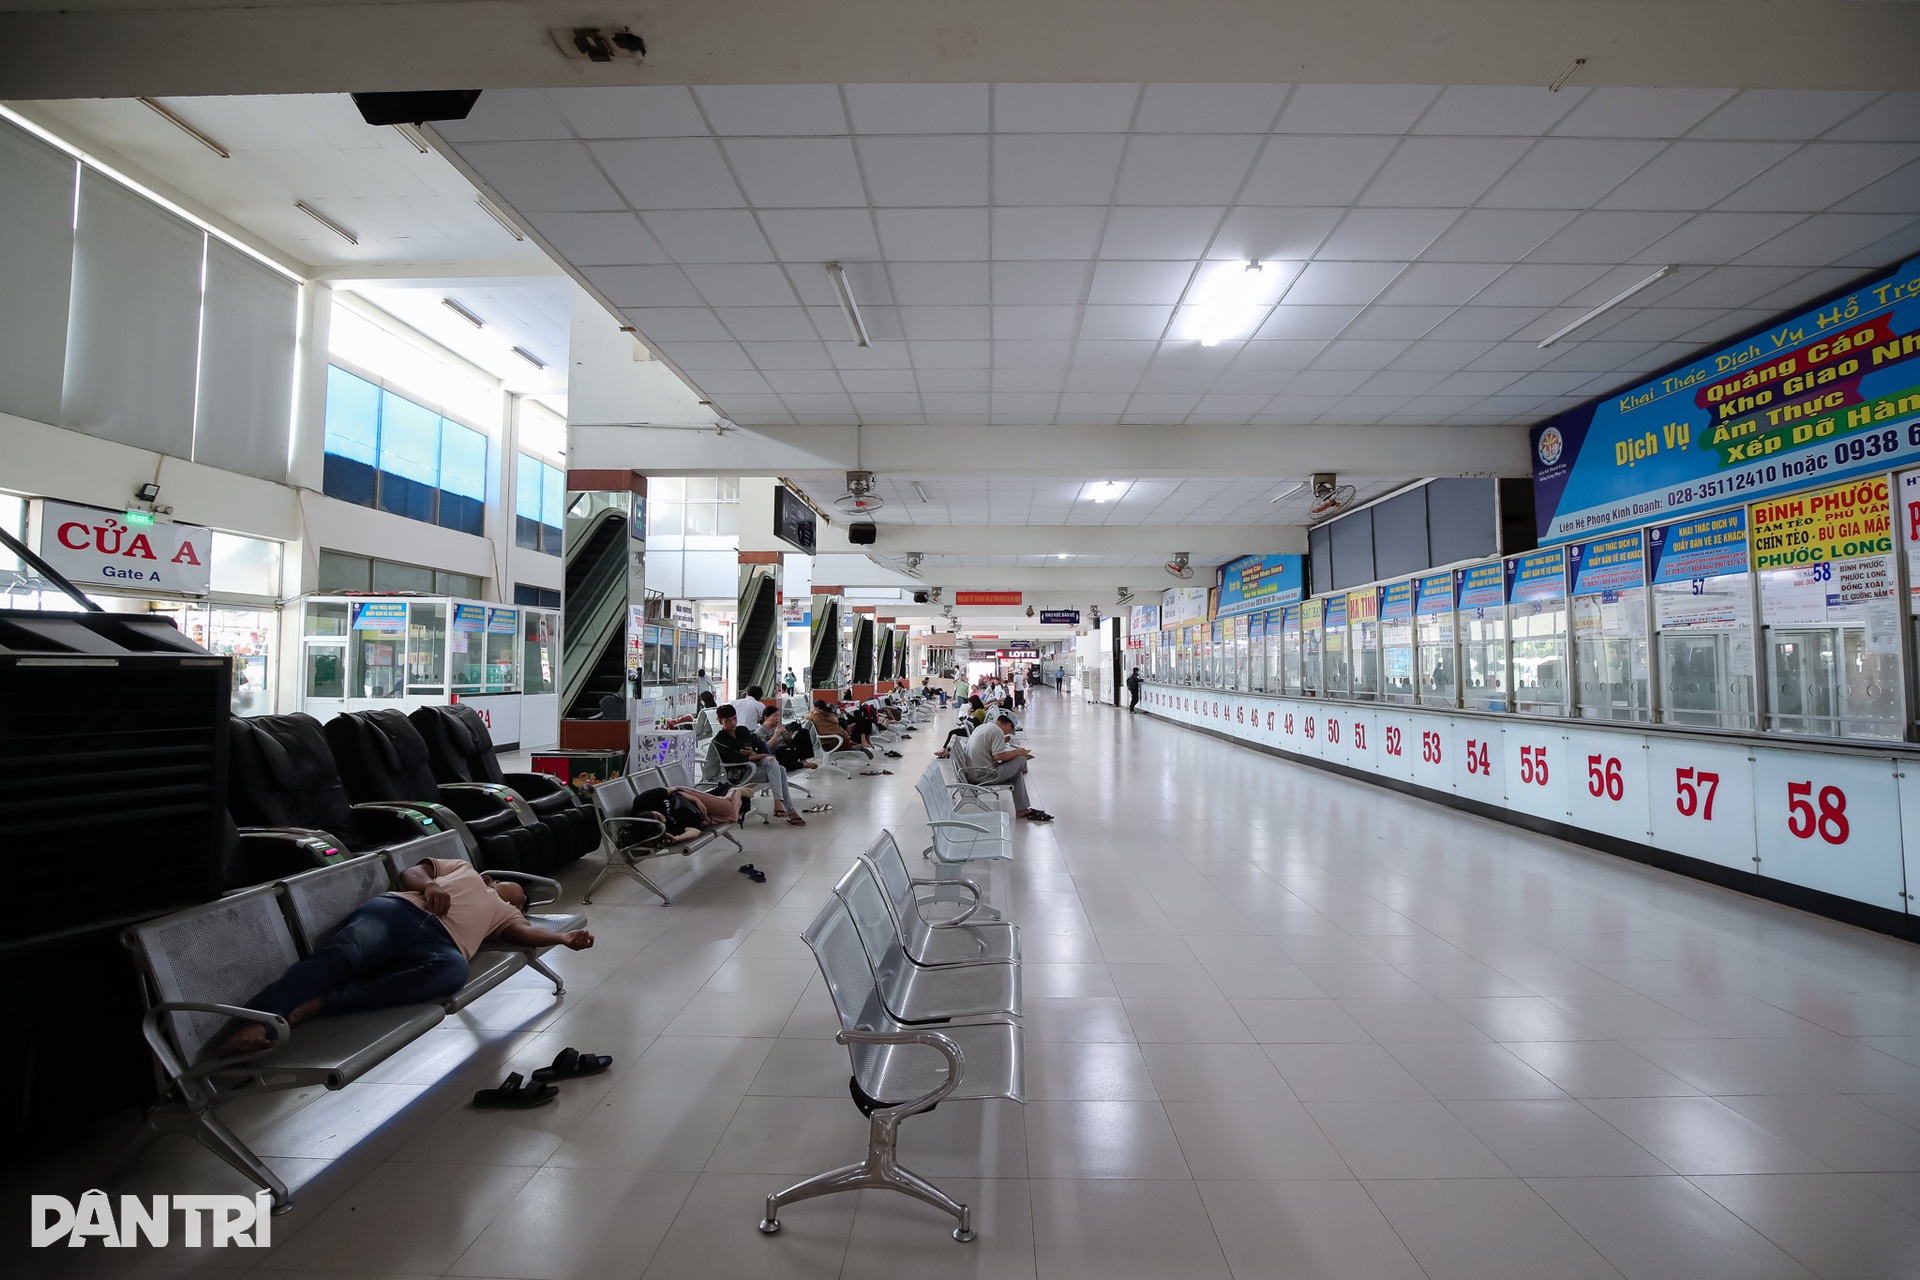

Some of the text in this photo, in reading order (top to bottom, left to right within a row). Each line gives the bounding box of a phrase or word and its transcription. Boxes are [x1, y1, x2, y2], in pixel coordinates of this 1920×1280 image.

[1620, 387, 1654, 411] Khai
[1662, 368, 1706, 393] Thác
[1715, 345, 1760, 371] Dịch
[1771, 328, 1803, 346] Vụ
[1816, 295, 1859, 329] Hỗ
[1707, 328, 1875, 402] Quảng Cáo
[1718, 390, 1772, 419] Kho
[1783, 359, 1859, 396] Giao
[1713, 391, 1844, 445] Ẩm Thực
[1615, 422, 1690, 467] Dịch Vụ
[1727, 434, 1782, 464] Xếp
[1792, 416, 1836, 445] Dỡ
[1559, 519, 1574, 533] Liên
[1576, 515, 1585, 530] Hệ
[1586, 512, 1610, 527] Phòng
[1612, 507, 1631, 521] Kinh
[1633, 499, 1663, 515] Doanh:
[1668, 466, 1776, 506] 028-35112410
[1782, 454, 1828, 477] hoặc
[1834, 429, 1899, 465] 0938
[1755, 482, 1889, 525] BÌNH PHƯỚC
[131, 514, 150, 524] EXIT
[1678, 516, 1738, 537] KHAI THÁC DỊCH VỤ
[1755, 522, 1783, 534] TÁM
[1786, 517, 1814, 528] TÈO
[1824, 508, 1854, 522] PHÚ
[57, 518, 202, 566] CỬA A
[1714, 532, 1722, 544] XE
[1724, 529, 1746, 543] KHÁCH
[1756, 531, 1783, 551] CHÍN
[1786, 528, 1809, 547] TÈO
[1818, 522, 1835, 541] BÙ
[1838, 521, 1861, 538] GIA
[1757, 537, 1892, 568] PHƯỚC LONG
[102, 566, 160, 582] Gate A
[1813, 562, 1831, 582] 58
[1867, 570, 1886, 578] LONG
[1692, 580, 1704, 595] 57
[1477, 608, 1484, 619] 54
[1213, 702, 1218, 718] 43
[1224, 704, 1230, 721] 44
[1237, 706, 1244, 724] 45
[1251, 708, 1258, 728] 46
[1267, 711, 1274, 731] 47
[1284, 713, 1294, 735] 48
[1304, 716, 1315, 739] 49
[1328, 718, 1340, 744] 50
[1354, 722, 1367, 750] 51
[1386, 726, 1402, 756] 52
[1423, 731, 1442, 764] 53
[1467, 740, 1490, 776] 54
[1520, 746, 1549, 786] 55
[1588, 754, 1624, 801] 56
[1676, 766, 1719, 820] 57
[1788, 781, 1850, 845] 58
